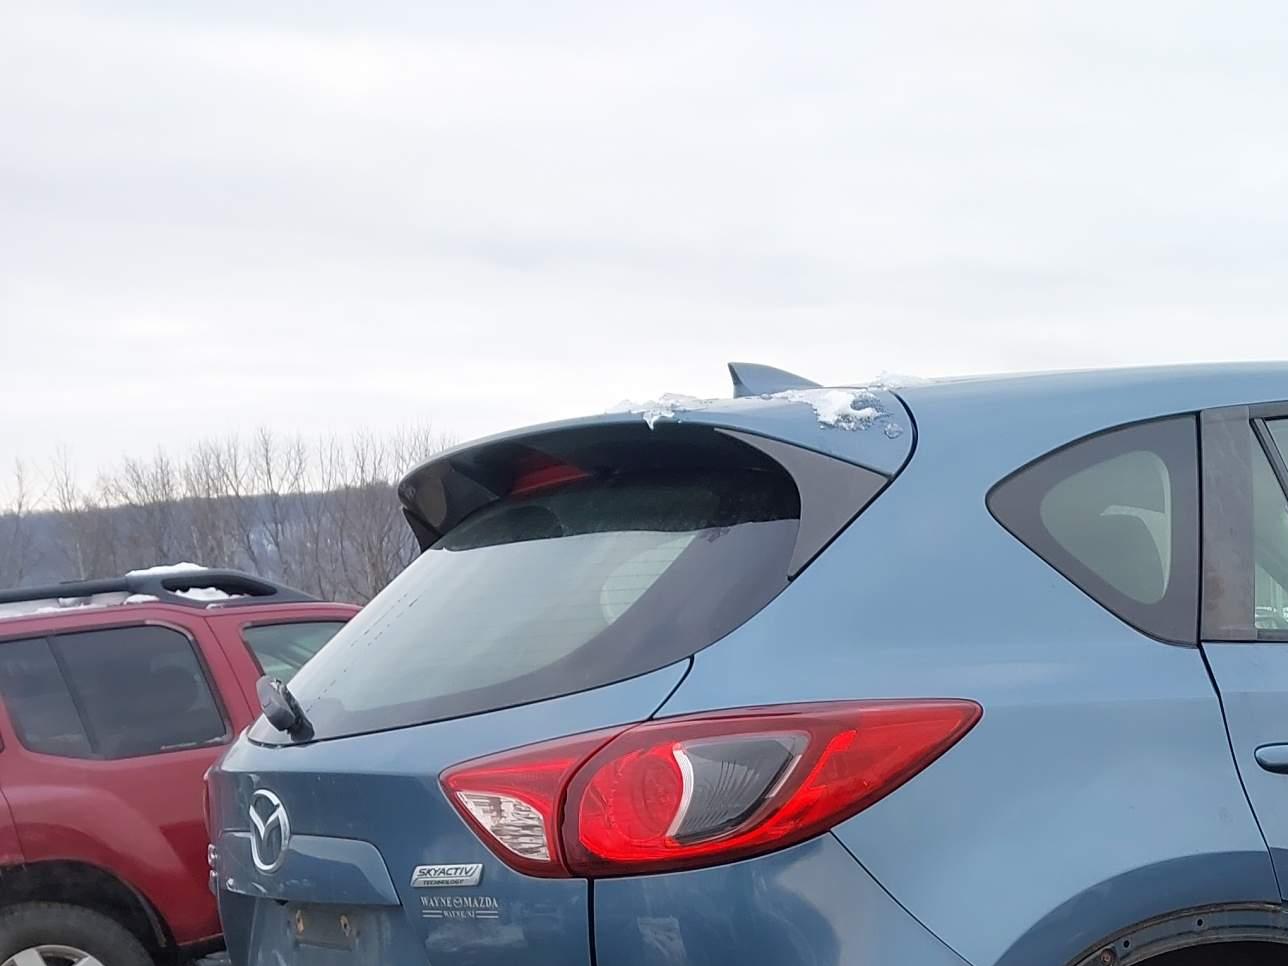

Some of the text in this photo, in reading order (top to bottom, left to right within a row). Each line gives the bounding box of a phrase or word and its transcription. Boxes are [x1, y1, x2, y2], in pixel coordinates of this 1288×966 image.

[417, 866, 473, 877] SKYACTIV
[420, 896, 499, 908] WAYNE MAZDA
